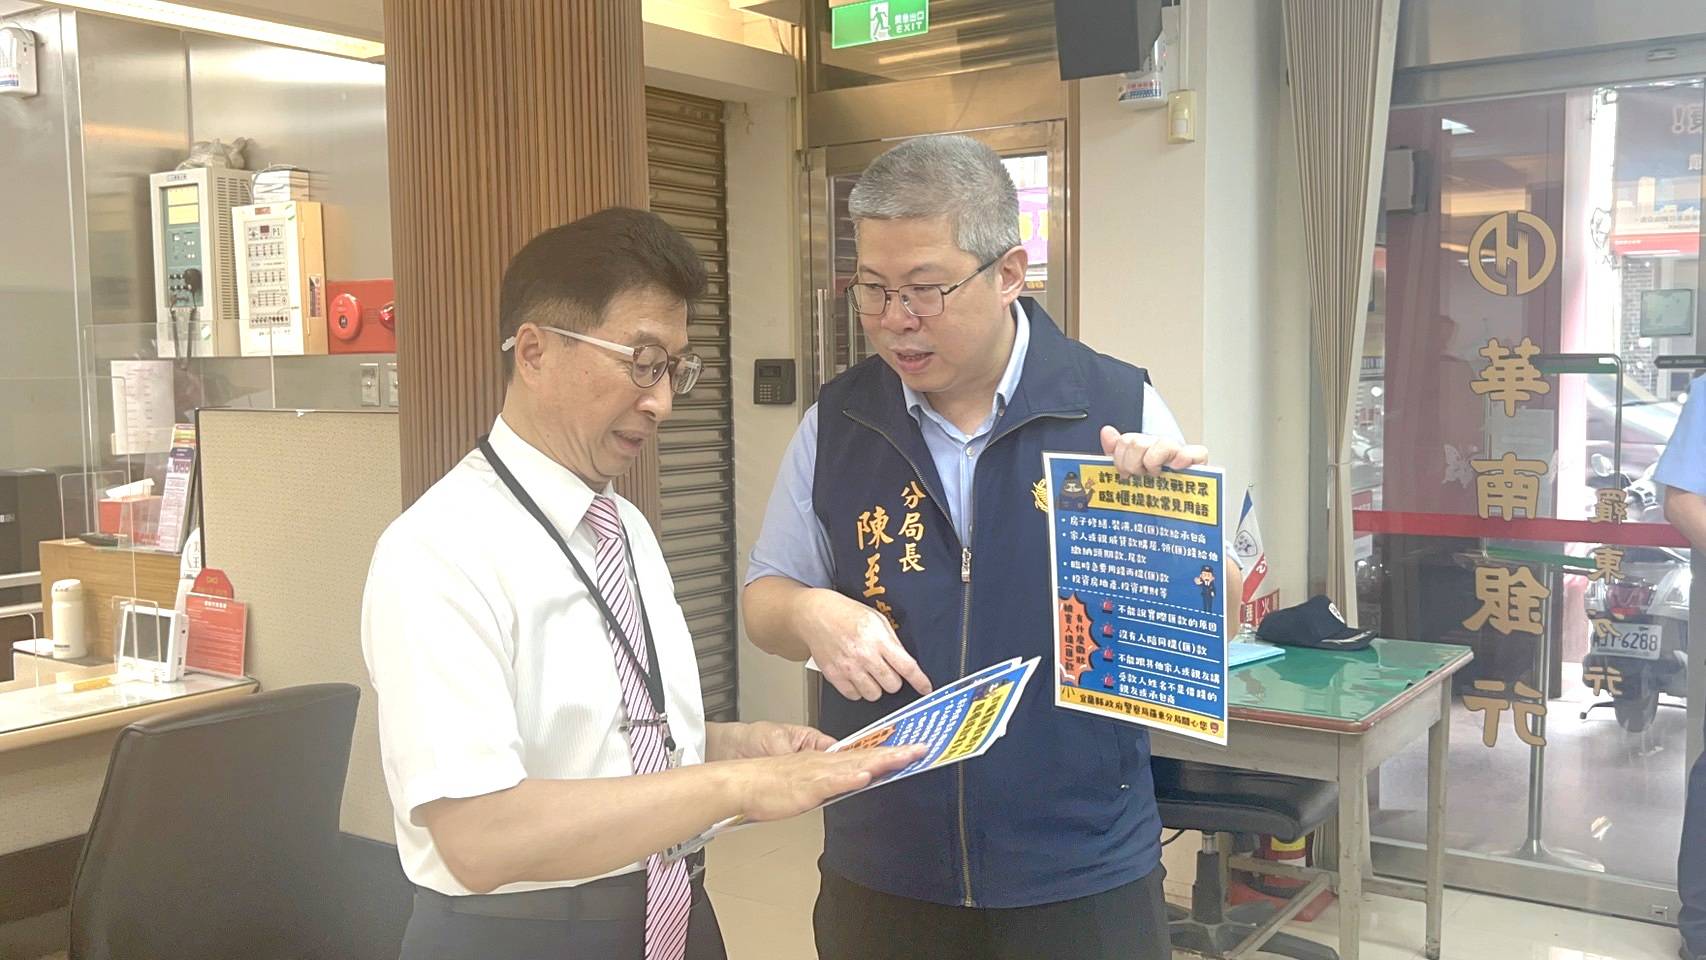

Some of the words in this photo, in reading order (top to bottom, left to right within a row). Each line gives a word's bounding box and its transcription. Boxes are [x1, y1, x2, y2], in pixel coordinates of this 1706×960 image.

[896, 21, 922, 33] EXIT
[1098, 490, 1208, 517] 臨櫃提款常見用語
[898, 481, 926, 573] 分局長
